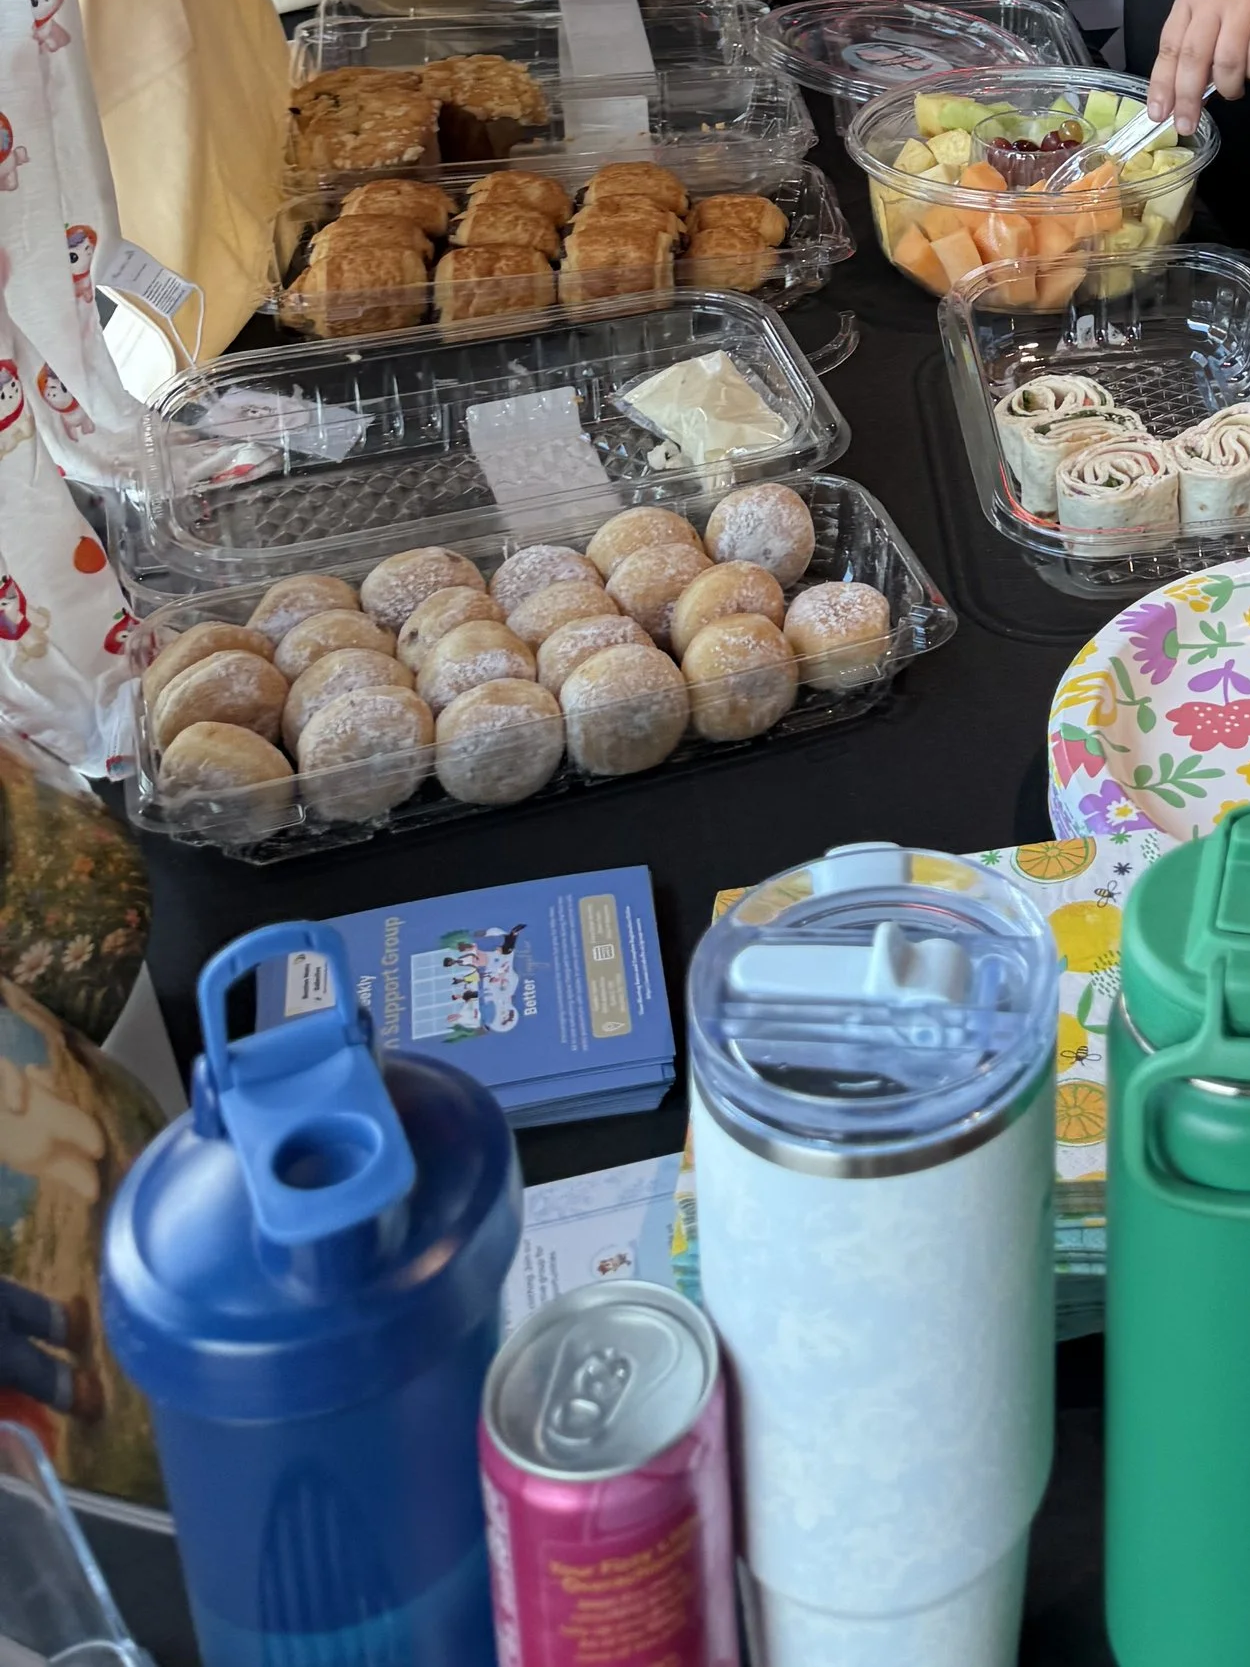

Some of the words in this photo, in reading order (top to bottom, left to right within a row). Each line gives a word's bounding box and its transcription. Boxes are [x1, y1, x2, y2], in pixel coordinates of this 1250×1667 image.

[380, 915, 407, 967] Group
[381, 967, 406, 1037] Support
[522, 977, 539, 1017] Better
